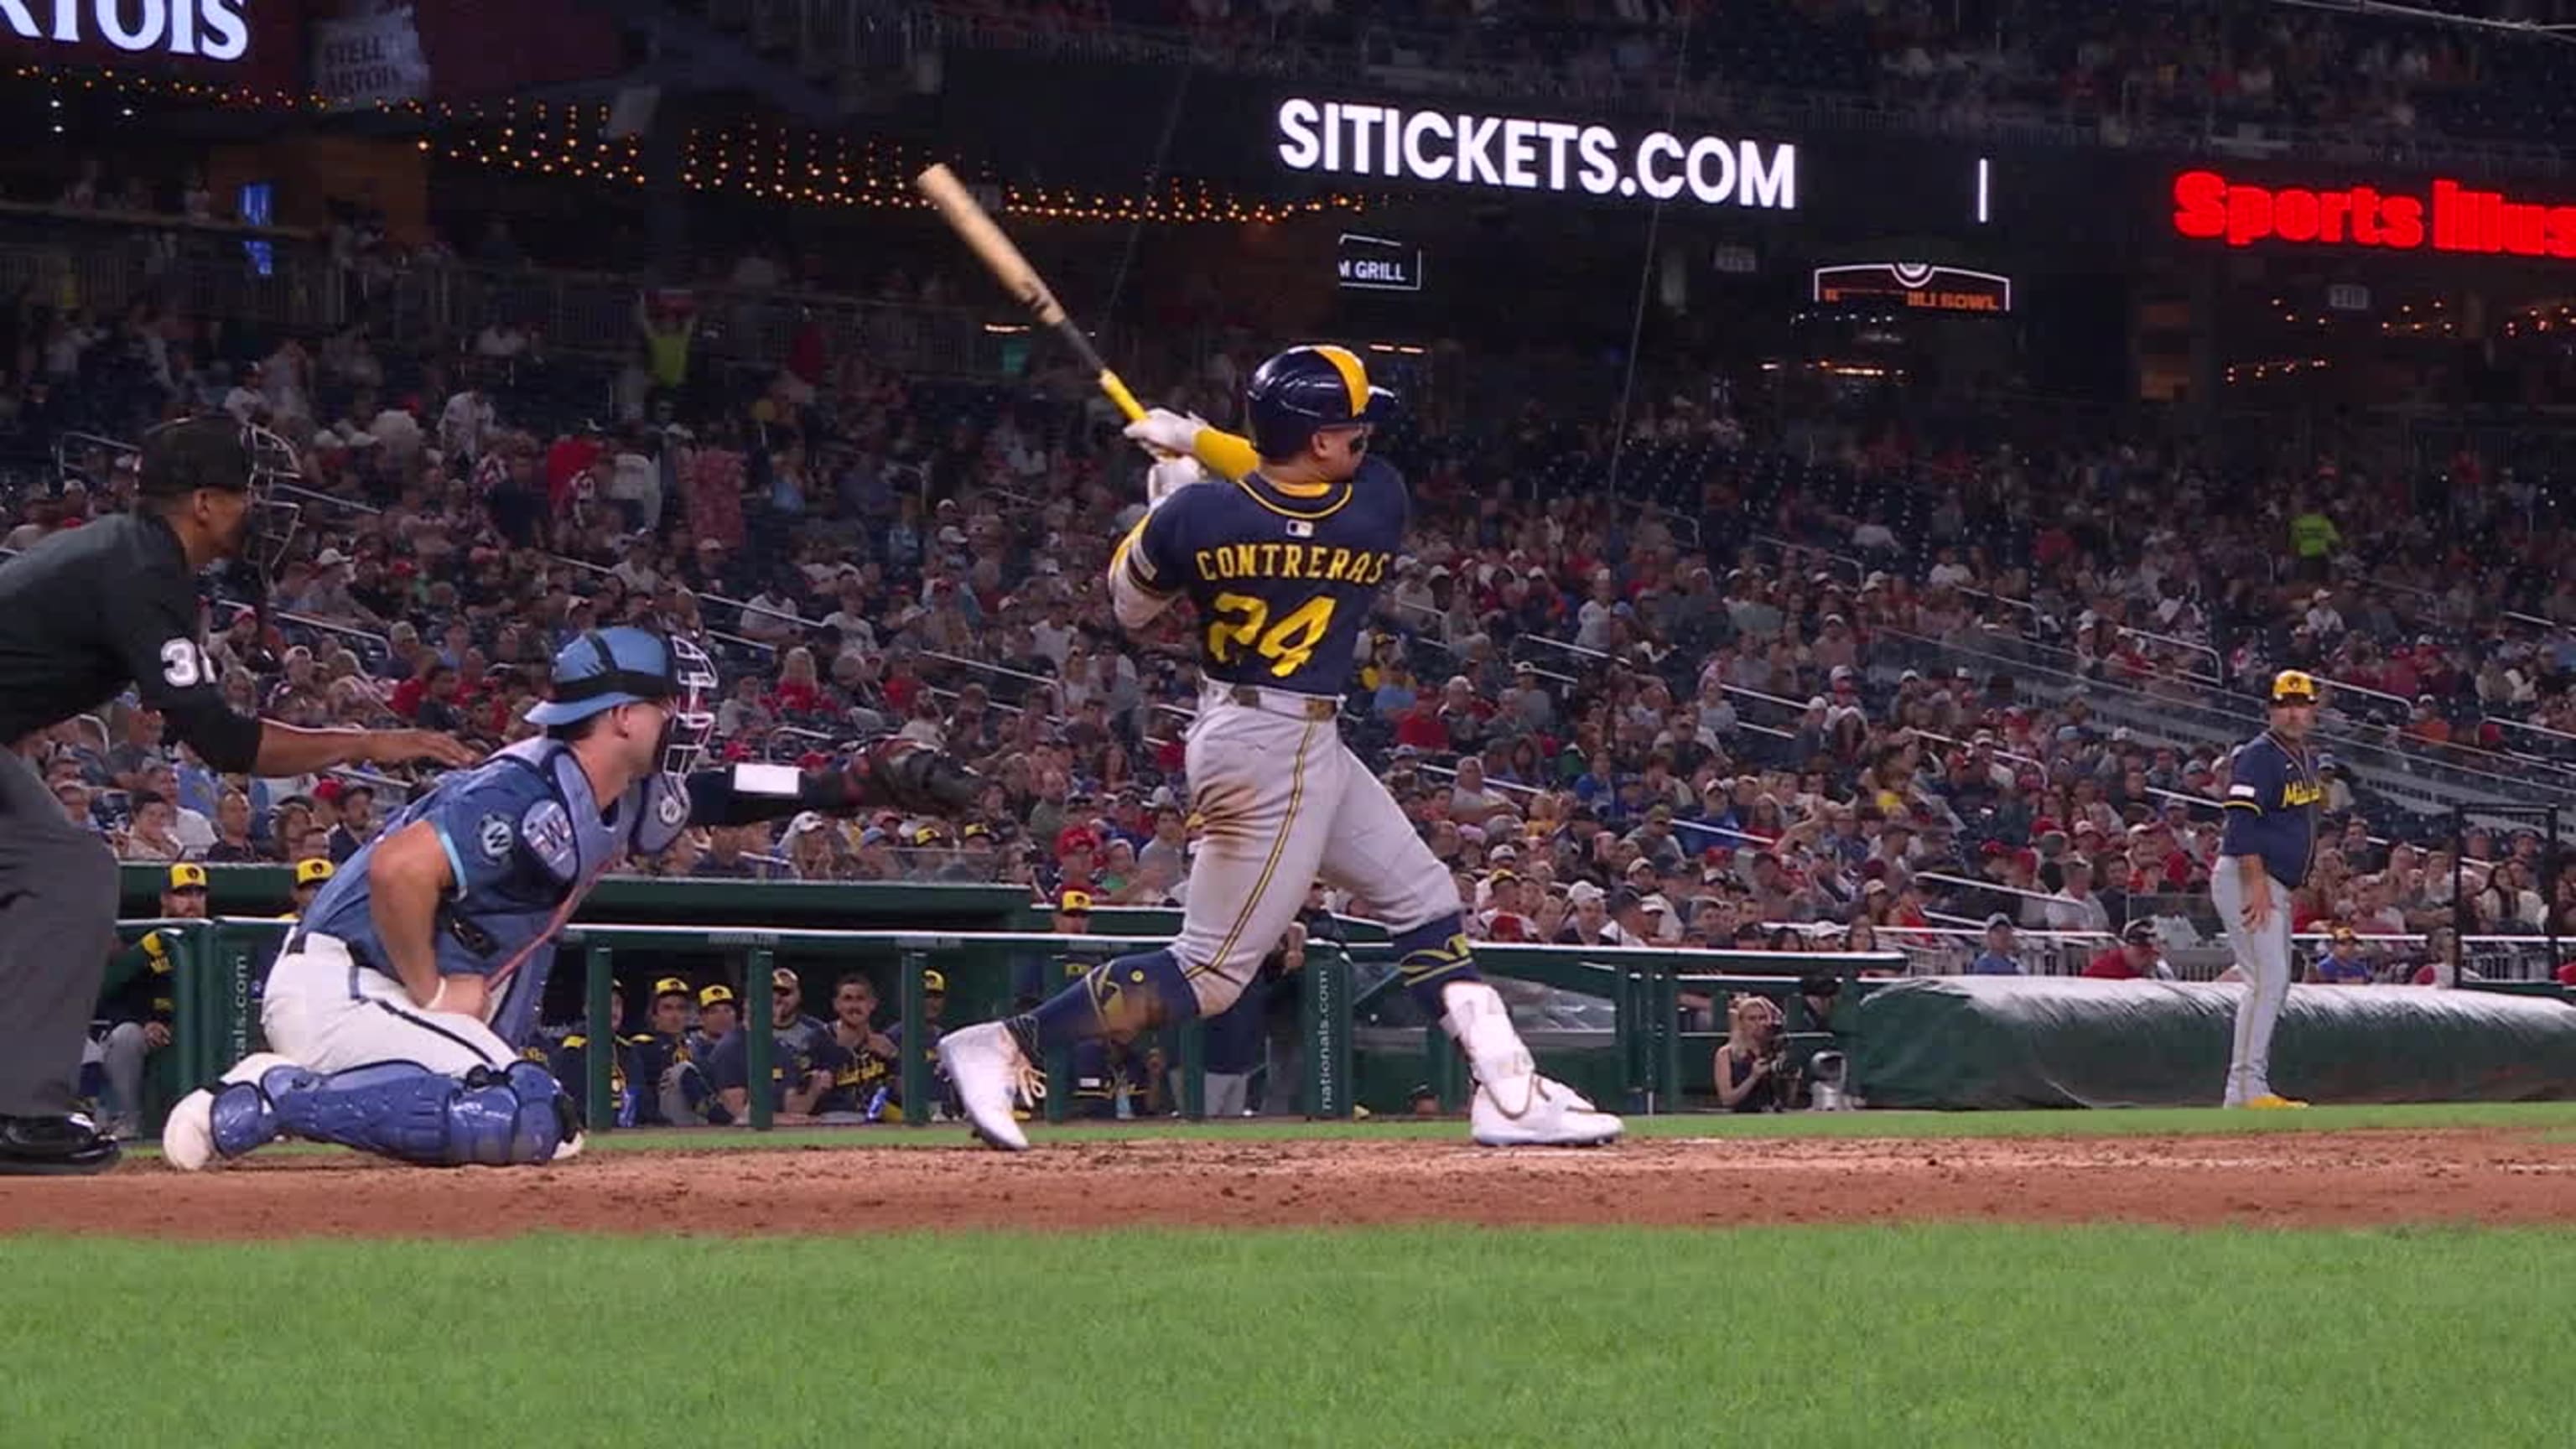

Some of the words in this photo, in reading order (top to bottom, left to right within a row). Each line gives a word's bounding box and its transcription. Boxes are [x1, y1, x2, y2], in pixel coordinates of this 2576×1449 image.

[1279, 98, 1795, 209] SITICKETS.COM
[2174, 171, 2423, 247] Sports
[1355, 261, 1407, 281] GRILL
[1196, 544, 1390, 584] CONTRERAS
[1208, 592, 1337, 677] 24
[1317, 970, 1332, 1110] nationals.com
